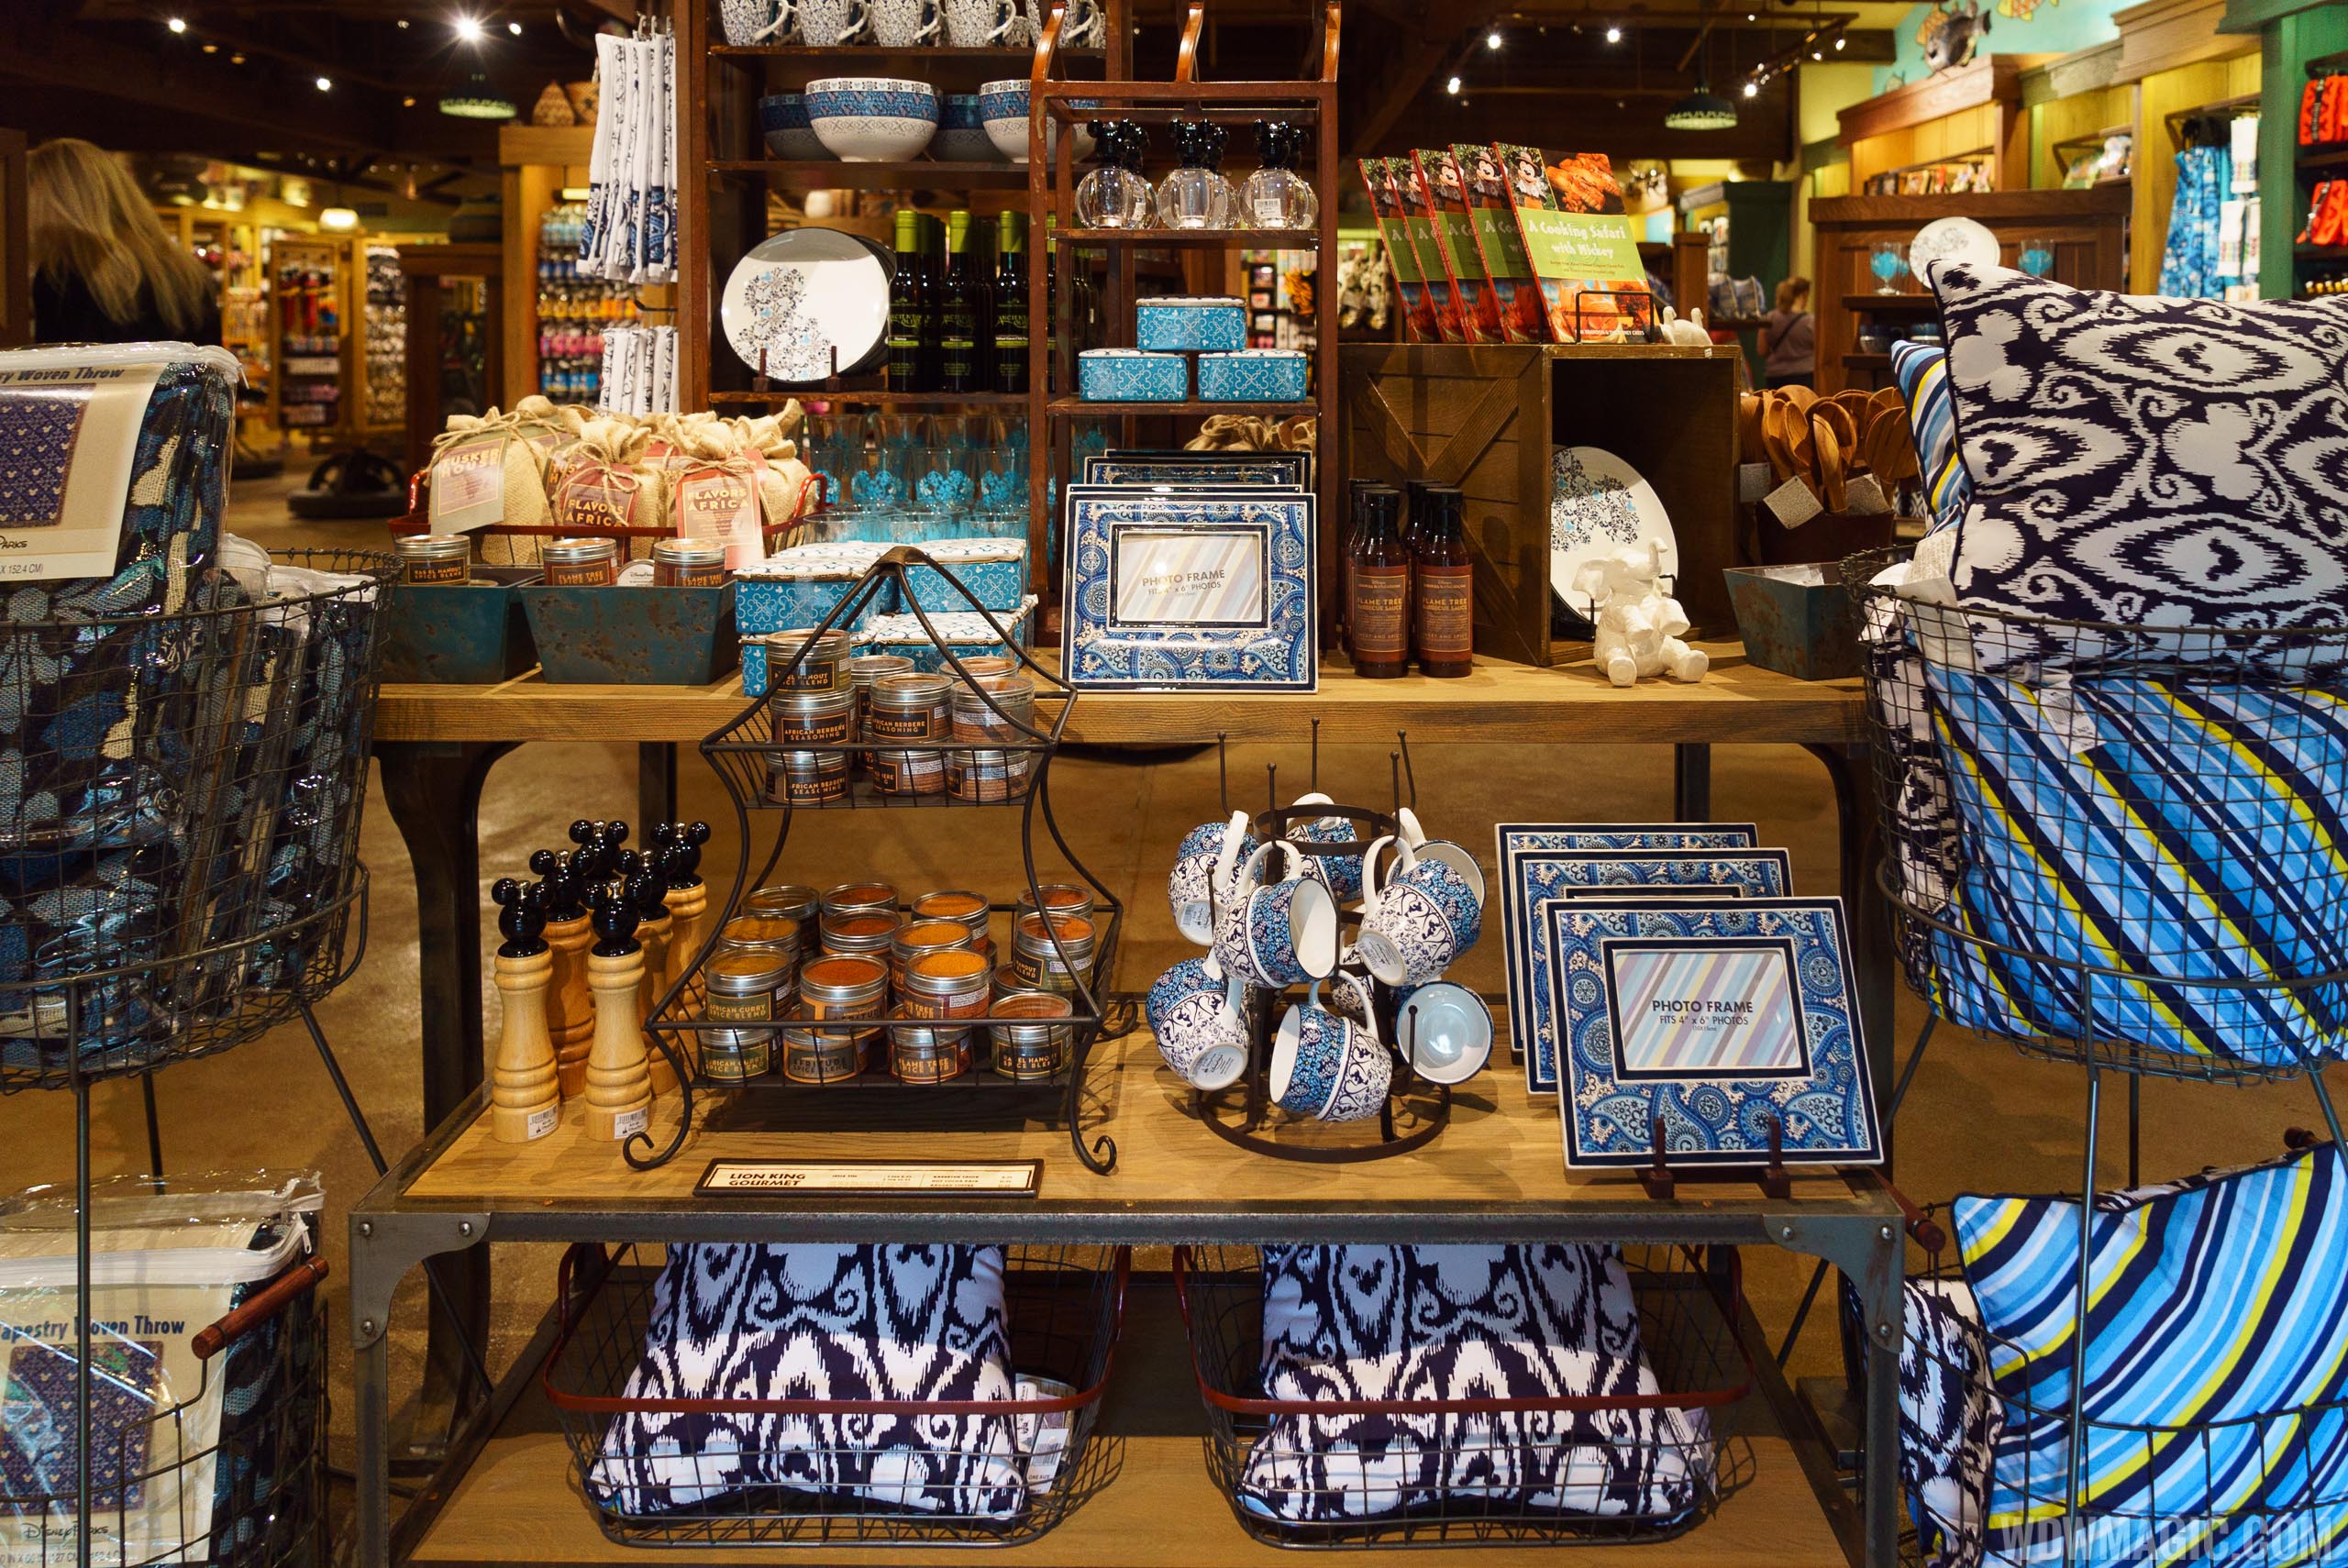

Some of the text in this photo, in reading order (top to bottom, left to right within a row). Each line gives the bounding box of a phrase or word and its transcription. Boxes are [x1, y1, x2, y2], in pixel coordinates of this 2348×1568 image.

[1540, 221, 1588, 240] Cooking
[1589, 224, 1626, 239] Safari
[1551, 241, 1614, 259] with Mickey
[17, 370, 71, 381] Woven
[75, 366, 126, 380] Throw
[440, 447, 500, 469] TUSKER
[687, 488, 748, 502] FLAVORS
[688, 499, 749, 512] AFRICA
[1142, 569, 1225, 587] PHOTO FRAME
[1191, 580, 1221, 591] PHOTOS
[816, 723, 846, 734] BERBERE
[875, 724, 918, 733] SEASONING
[791, 730, 840, 741] SEASONING
[739, 1003, 766, 1013] CURRY
[1652, 999, 1754, 1013] PHOTO FRAME
[734, 1010, 766, 1019] BLEND
[1659, 1015, 1677, 1024] FITS
[1712, 1015, 1749, 1026] PHOTOS
[734, 1062, 764, 1072] BEND
[1003, 1061, 1027, 1069] SPCE
[0, 1315, 185, 1344] apestry oven Throw
